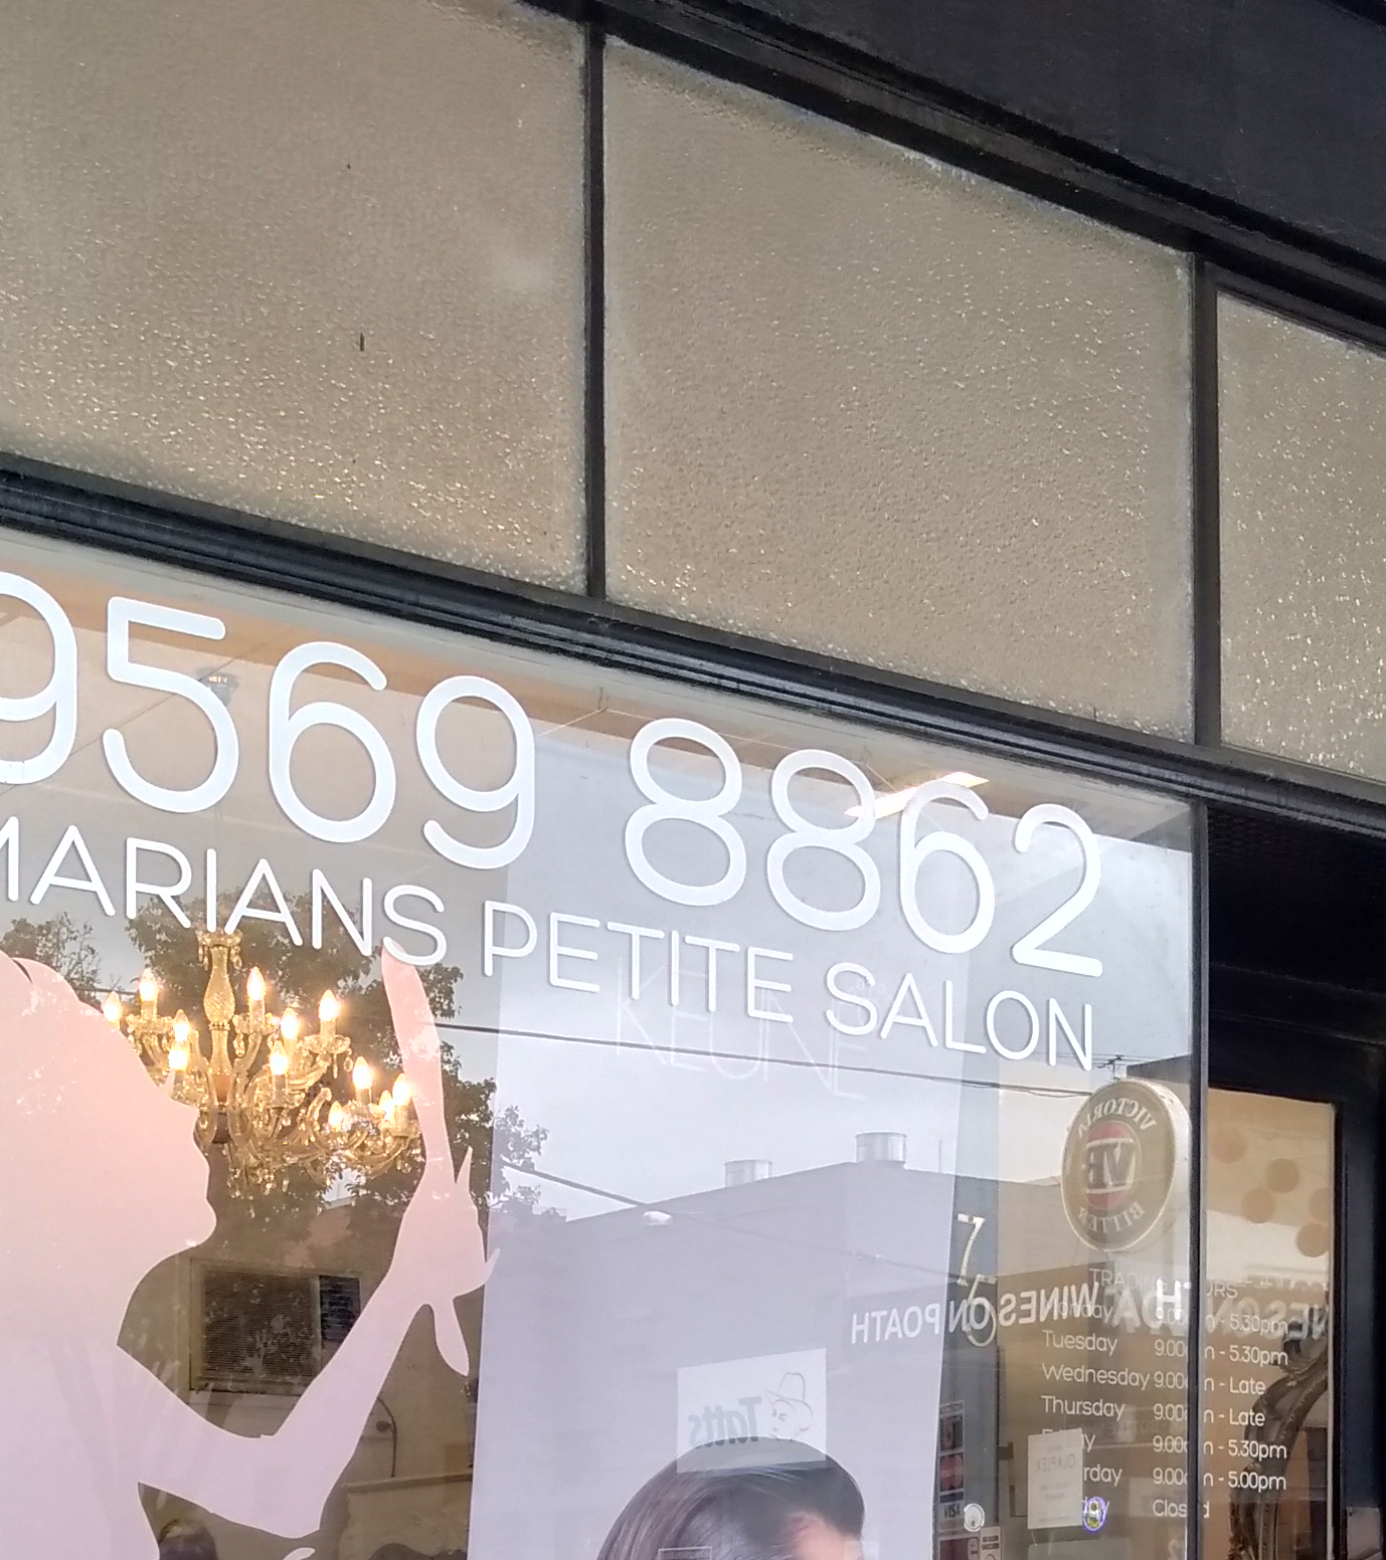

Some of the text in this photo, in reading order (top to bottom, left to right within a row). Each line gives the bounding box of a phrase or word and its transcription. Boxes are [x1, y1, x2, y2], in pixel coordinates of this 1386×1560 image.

[624, 717, 1104, 978] 8862
[483, 900, 794, 1022] PETITE
[825, 962, 1093, 1072] SALON
[1042, 1330, 1118, 1355] Tuesday
[1229, 1345, 1288, 1368] 5.30pm
[1042, 1362, 1150, 1391] Wednesday
[1229, 1376, 1266, 1396] Late
[1041, 1395, 1125, 1421] Thursday
[1229, 1407, 1265, 1427] Late
[1228, 1439, 1287, 1461] 5.30pm
[1228, 1471, 1287, 1493] 5.00pm
